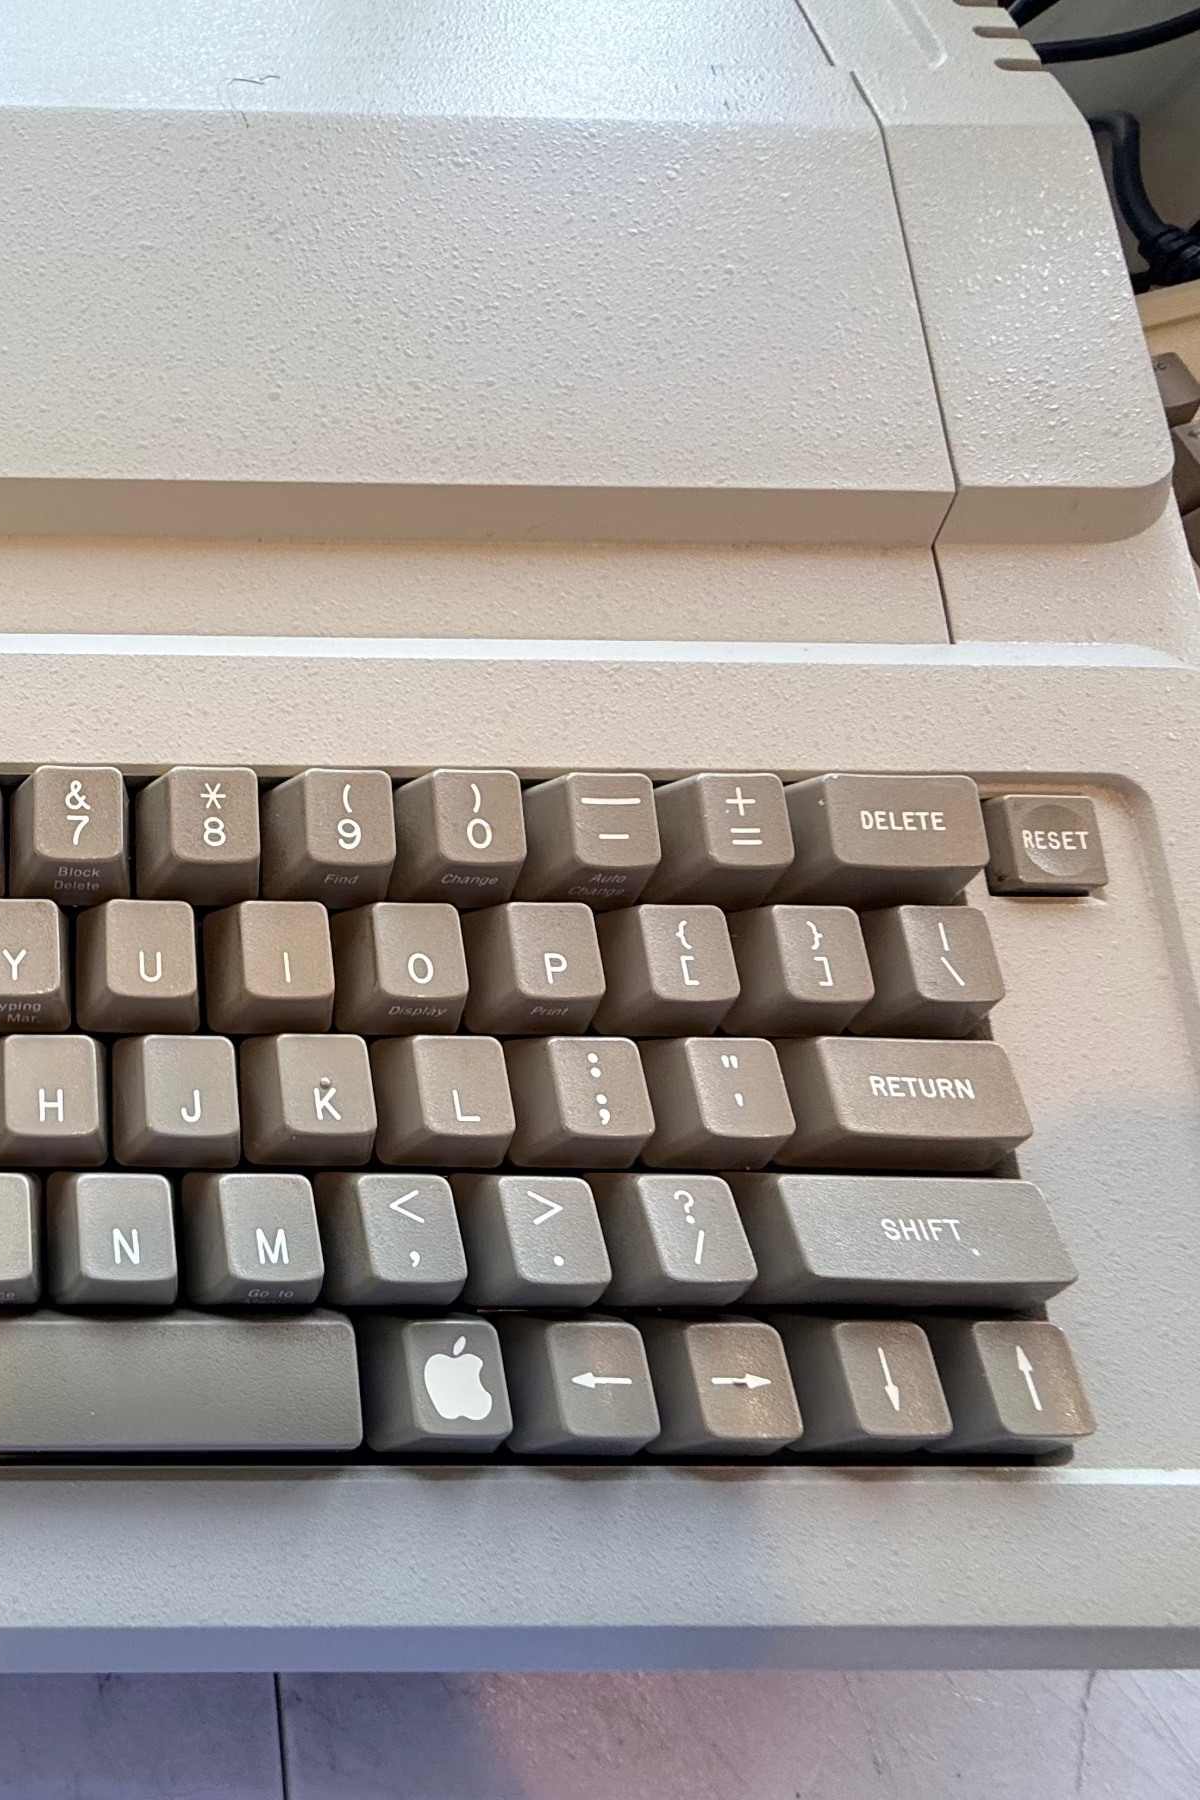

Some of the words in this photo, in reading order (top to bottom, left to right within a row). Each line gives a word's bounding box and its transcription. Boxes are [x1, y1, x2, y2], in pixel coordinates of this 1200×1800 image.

[64, 780, 91, 810] &
[342, 784, 353, 813] (
[470, 783, 481, 813] )
[724, 787, 757, 817] +
[66, 814, 90, 846] 7
[203, 816, 227, 847] 8
[337, 818, 362, 850] 9
[466, 818, 493, 849] 0
[860, 810, 947, 831] DELETE
[730, 827, 763, 846] =
[1022, 829, 1089, 850] RESET
[53, 880, 100, 892] Delete
[58, 865, 100, 878] Block
[324, 873, 358, 885] Find
[441, 872, 499, 887] Change
[589, 873, 627, 883] Auto
[568, 886, 625, 897] Change
[675, 920, 692, 950] {
[806, 920, 823, 950] }
[2, 949, 27, 981] Y
[139, 950, 162, 983] U
[283, 951, 292, 983] I
[407, 953, 434, 984] O
[543, 952, 568, 985] P
[680, 955, 700, 986] [
[813, 956, 834, 987] ]
[940, 956, 966, 987] \
[388, 1005, 448, 1018] Display
[530, 1006, 569, 1016] Print
[587, 1052, 602, 1078] :
[868, 1075, 975, 1099] RETURN
[38, 1088, 64, 1122] H
[181, 1089, 201, 1123] J
[313, 1087, 342, 1121] K
[452, 1089, 481, 1122] L
[596, 1094, 611, 1125] ;
[389, 1189, 425, 1224] <
[526, 1190, 564, 1226] >
[673, 1189, 696, 1225] ?
[880, 1218, 961, 1241] SHIFT
[112, 1228, 140, 1265] N
[255, 1228, 290, 1265] M
[694, 1229, 705, 1265] /
[248, 1288, 270, 1299] Go
[278, 1288, 295, 1299] to
